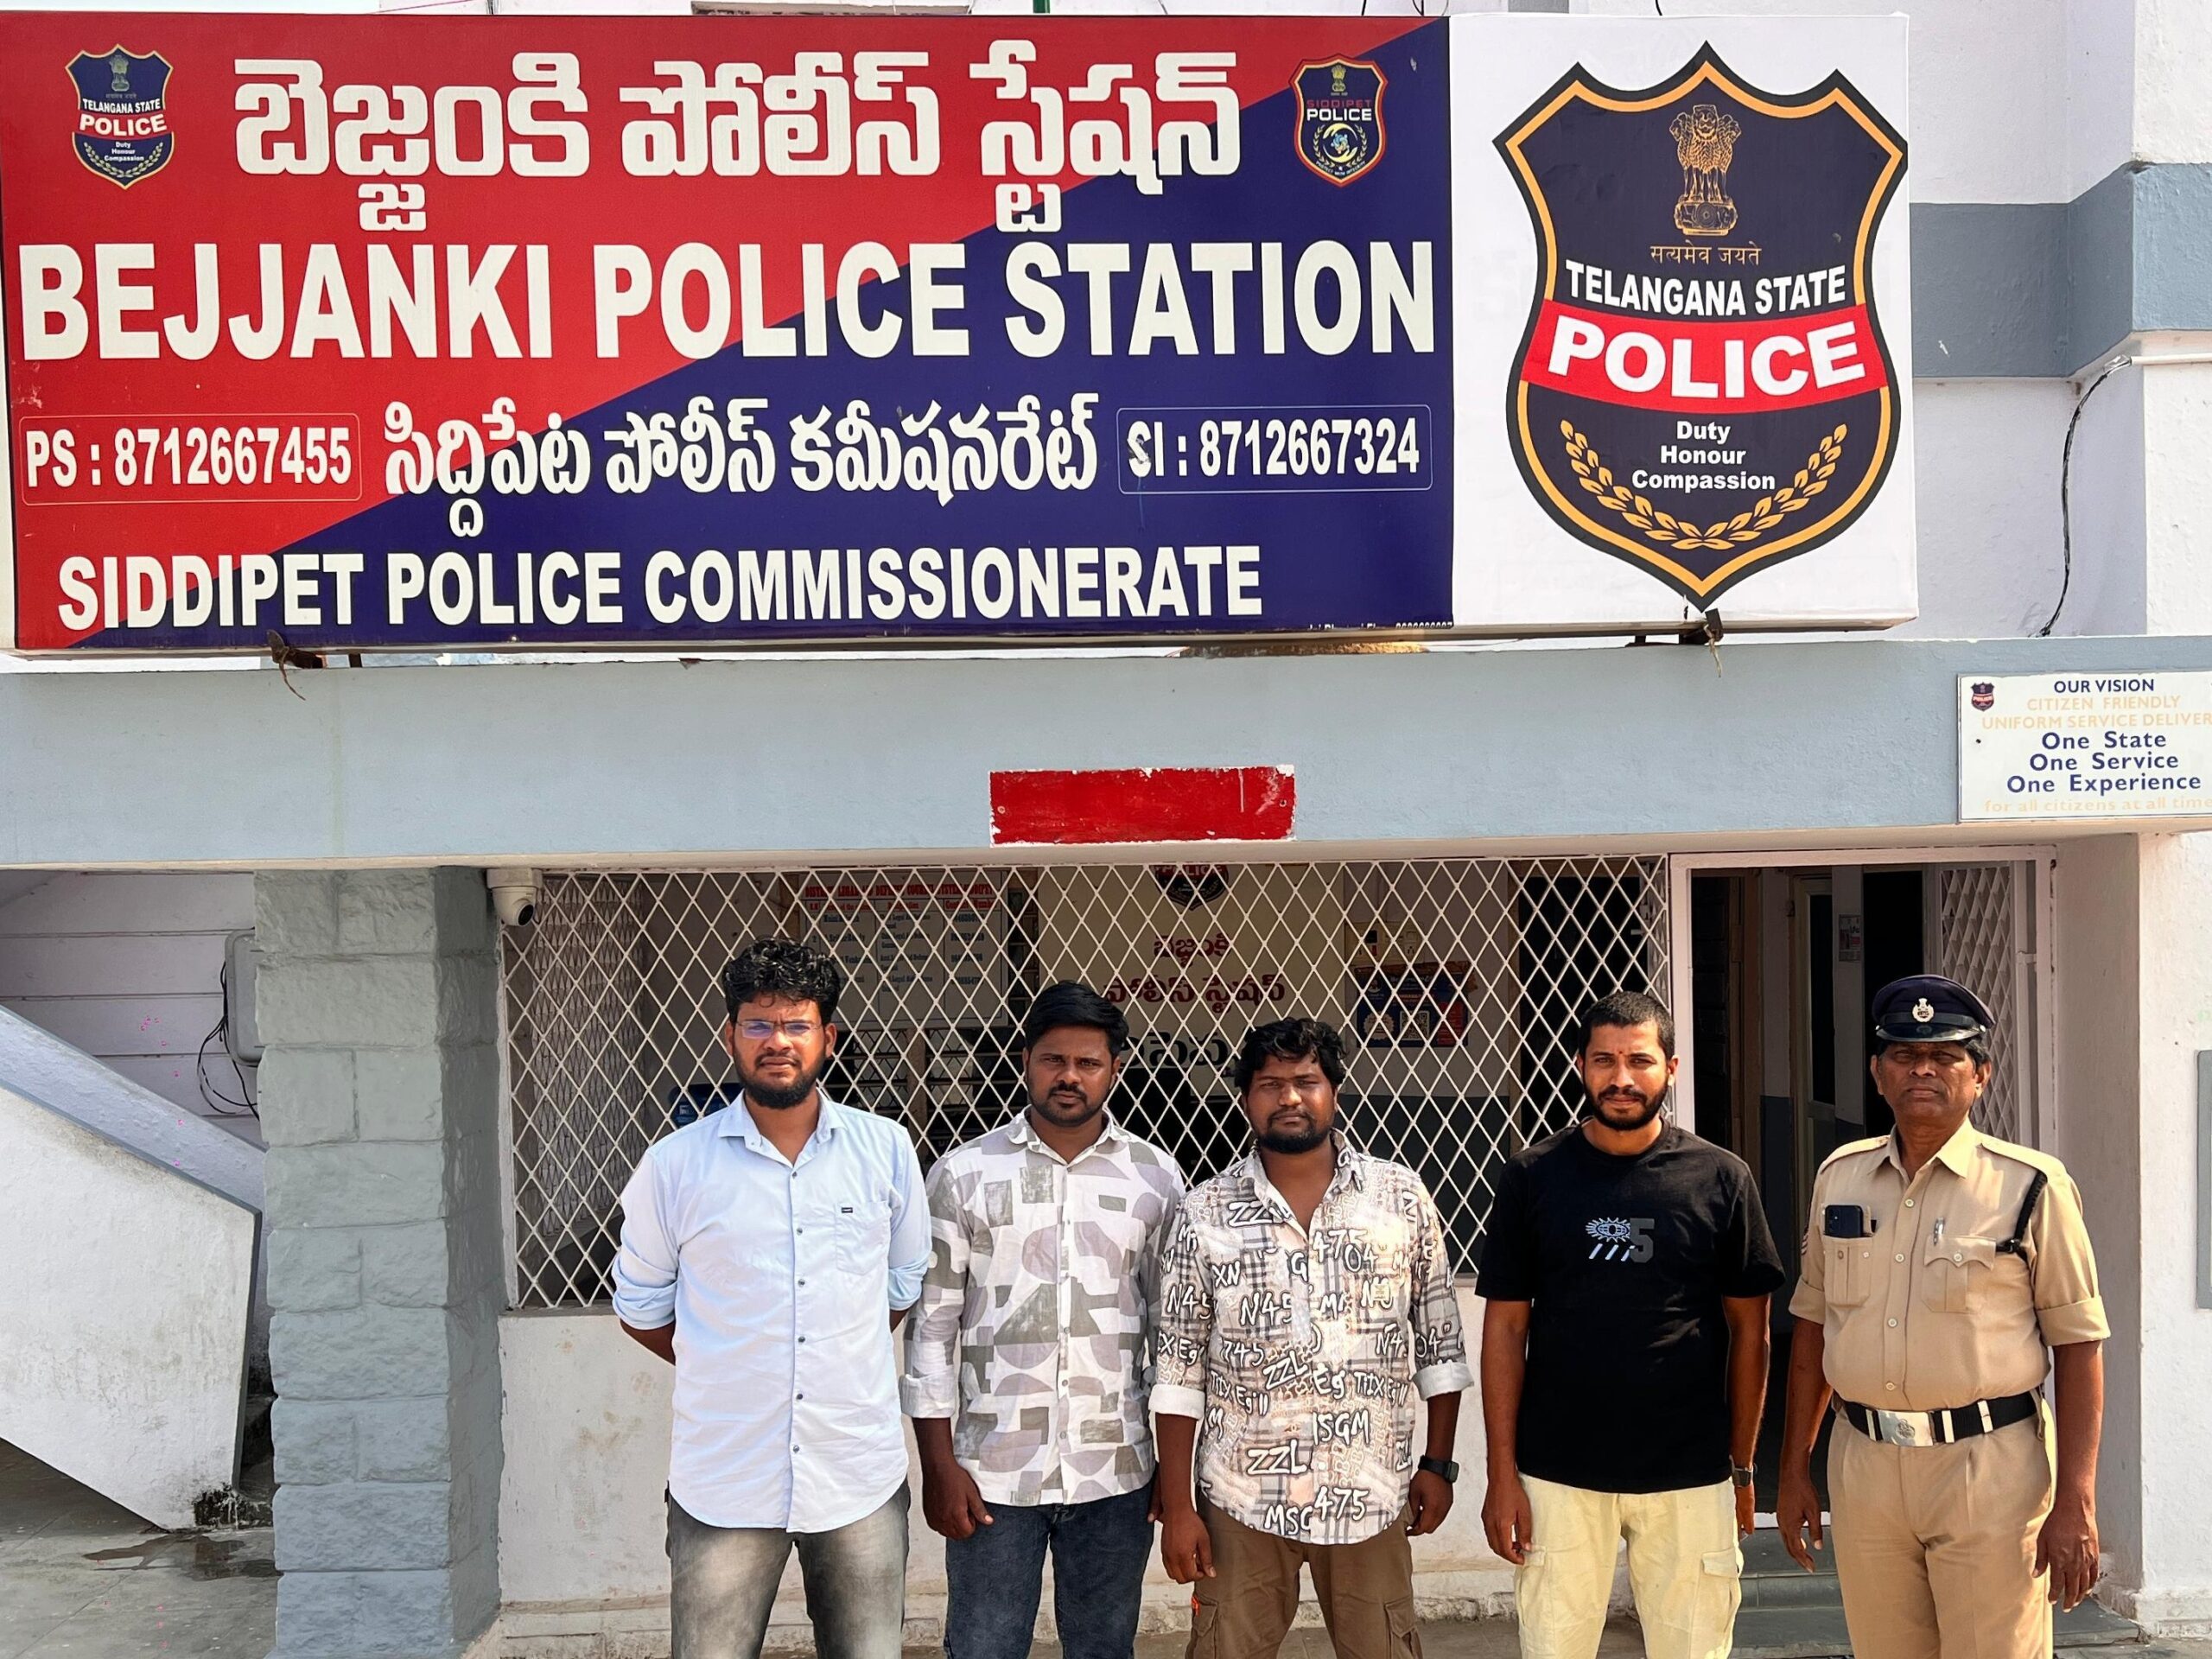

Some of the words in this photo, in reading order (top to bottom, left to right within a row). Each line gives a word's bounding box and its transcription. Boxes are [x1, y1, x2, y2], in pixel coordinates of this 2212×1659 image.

[82, 98, 133, 114] TELANGANA
[135, 98, 161, 113] STATE
[1306, 108, 1372, 121] POLICE
[79, 113, 167, 137] POLICE
[234, 52, 590, 232] బెజ్జంకి
[620, 51, 940, 176] పోలీస్
[969, 40, 1241, 232] స్టేషన్
[1649, 239, 1712, 264] सत्यमेव
[1718, 240, 1762, 265] जयते
[1565, 258, 1745, 316] TELANGANA
[1755, 265, 1846, 310] STATE
[19, 243, 552, 360] BEJJANKI
[594, 241, 969, 359] POLICE
[1005, 239, 1434, 358] STATION
[1548, 315, 1866, 399] POLICE
[1676, 421, 1731, 444] Duty
[114, 426, 352, 486] 8712667455
[603, 396, 776, 493] పోలీస్
[789, 392, 1099, 507] కమీషనరేట్
[1200, 417, 1420, 476] 8712667324
[1660, 445, 1746, 465] Honour
[1631, 470, 1776, 493] Compassion
[58, 553, 364, 631] SIDDIPET
[387, 551, 623, 626] POLICE
[645, 545, 1262, 624] COMMISSIONERATE
[2054, 680, 2091, 694] OUR
[2095, 678, 2155, 692] VISION
[2026, 697, 2094, 711] CITIZEN
[2102, 695, 2181, 710] FRIENDLY
[1981, 716, 2063, 730] UNIFORM
[2068, 714, 2138, 728] SERVICE
[2042, 732, 2089, 750] One
[2104, 730, 2167, 749] State
[2030, 753, 2077, 772] One
[2092, 751, 2178, 770] Service
[2006, 775, 2055, 793] One
[2069, 772, 2201, 796] Experience
[1984, 800, 2010, 812] for
[2018, 799, 2037, 811] all
[2044, 798, 2115, 811] citizens
[2122, 798, 2141, 810] at
[2146, 797, 2166, 809] all
